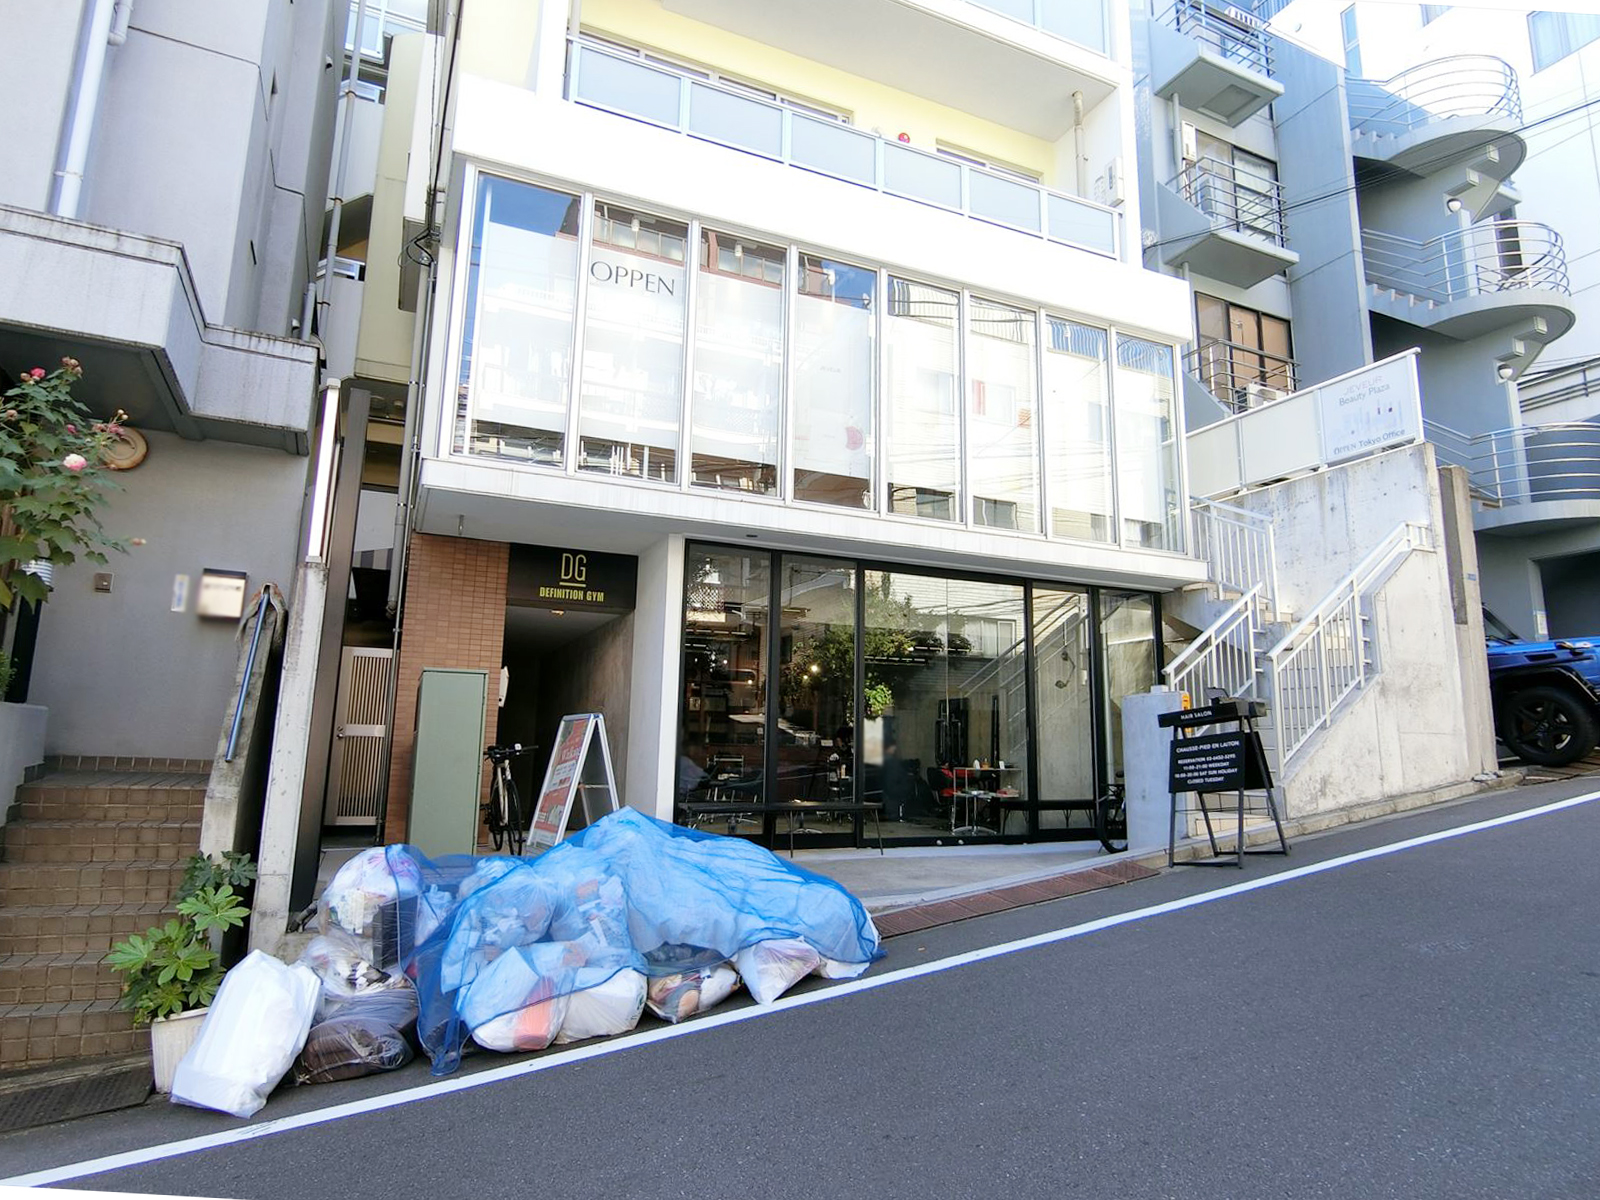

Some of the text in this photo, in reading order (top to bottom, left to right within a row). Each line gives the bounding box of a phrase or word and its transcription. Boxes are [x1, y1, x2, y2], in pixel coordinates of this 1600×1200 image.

[590, 260, 675, 296] OPPEN
[1339, 384, 1390, 406] Beauty Plaza
[1359, 436, 1382, 447] Tokyo
[1382, 429, 1406, 441] Office
[561, 552, 587, 581] DG
[539, 586, 605, 602] DEFINITION GYM
